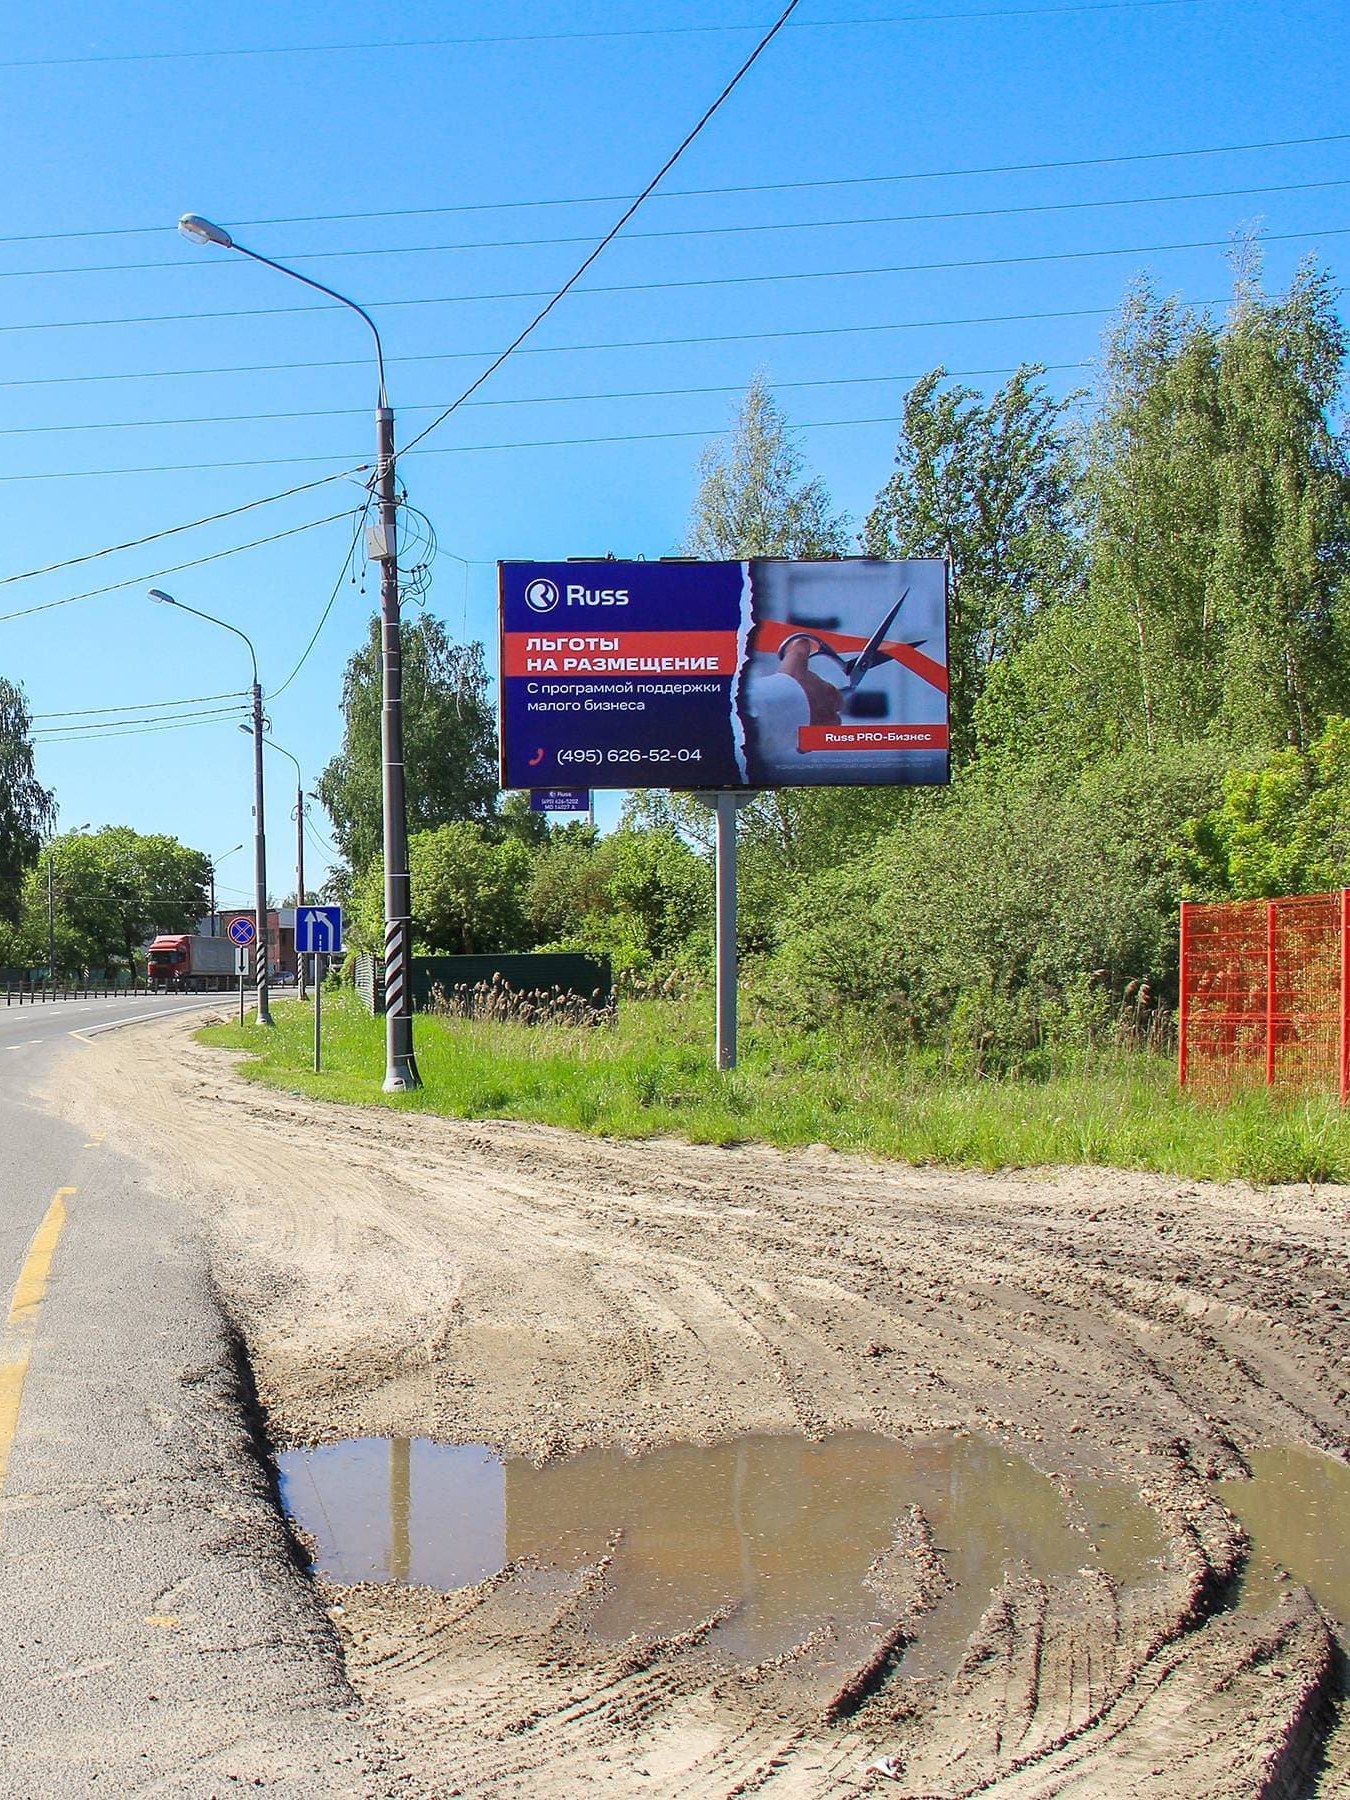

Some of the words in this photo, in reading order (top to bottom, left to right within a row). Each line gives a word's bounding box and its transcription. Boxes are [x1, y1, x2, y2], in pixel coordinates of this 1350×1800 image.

[566, 585, 629, 606] Russ
[526, 637, 619, 651] ЛЬГОТЫ
[526, 658, 558, 671] НА
[563, 657, 719, 673] РАЗМЕЩЕНИЕ
[527, 682, 539, 694] С
[541, 682, 634, 696] программой
[636, 682, 721, 696] поддержки
[527, 701, 581, 711] малого
[584, 699, 645, 711] бизнеса
[825, 733, 855, 742] Russ
[856, 732, 932, 742] PRO-Бизнес
[557, 749, 603, 765] (495)
[607, 749, 702, 762] 626-52-04
